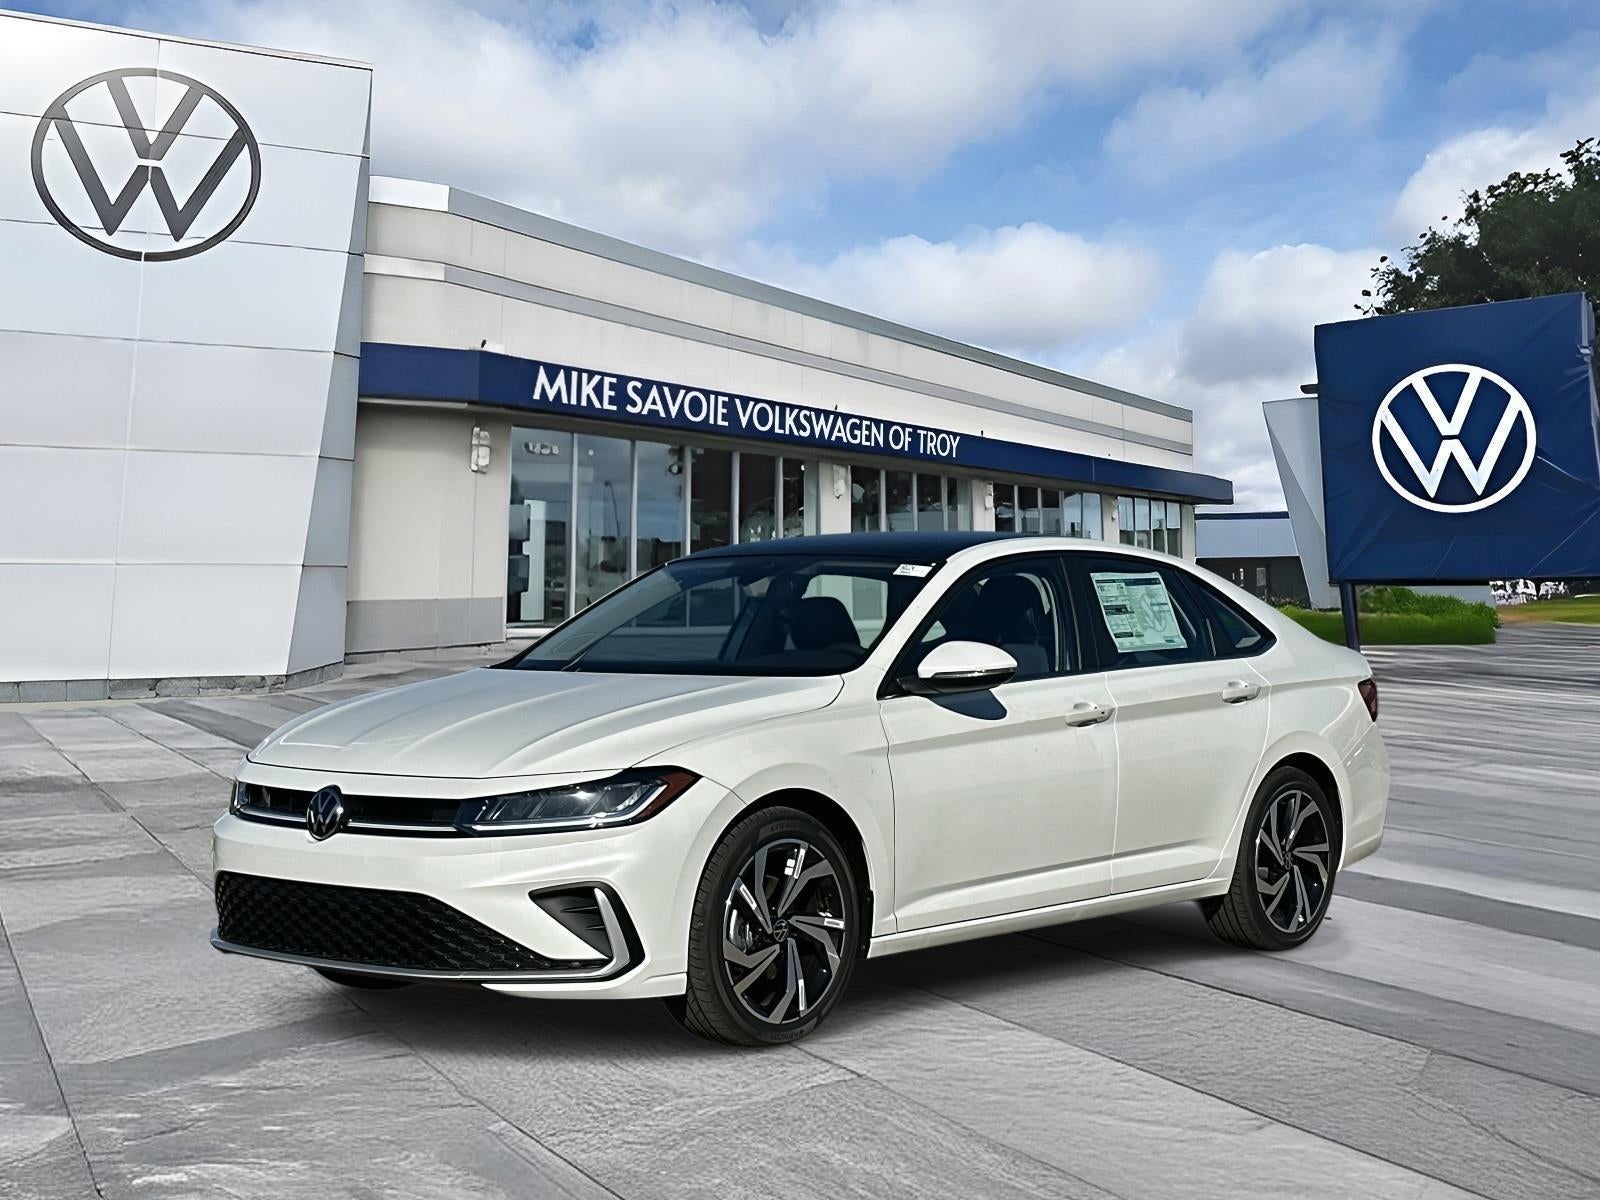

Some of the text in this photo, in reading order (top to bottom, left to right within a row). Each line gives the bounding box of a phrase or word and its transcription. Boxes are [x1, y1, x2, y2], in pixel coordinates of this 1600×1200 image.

[532, 365, 961, 459] MIKE SAVOIE VOLKSWAGEN OF TROY
